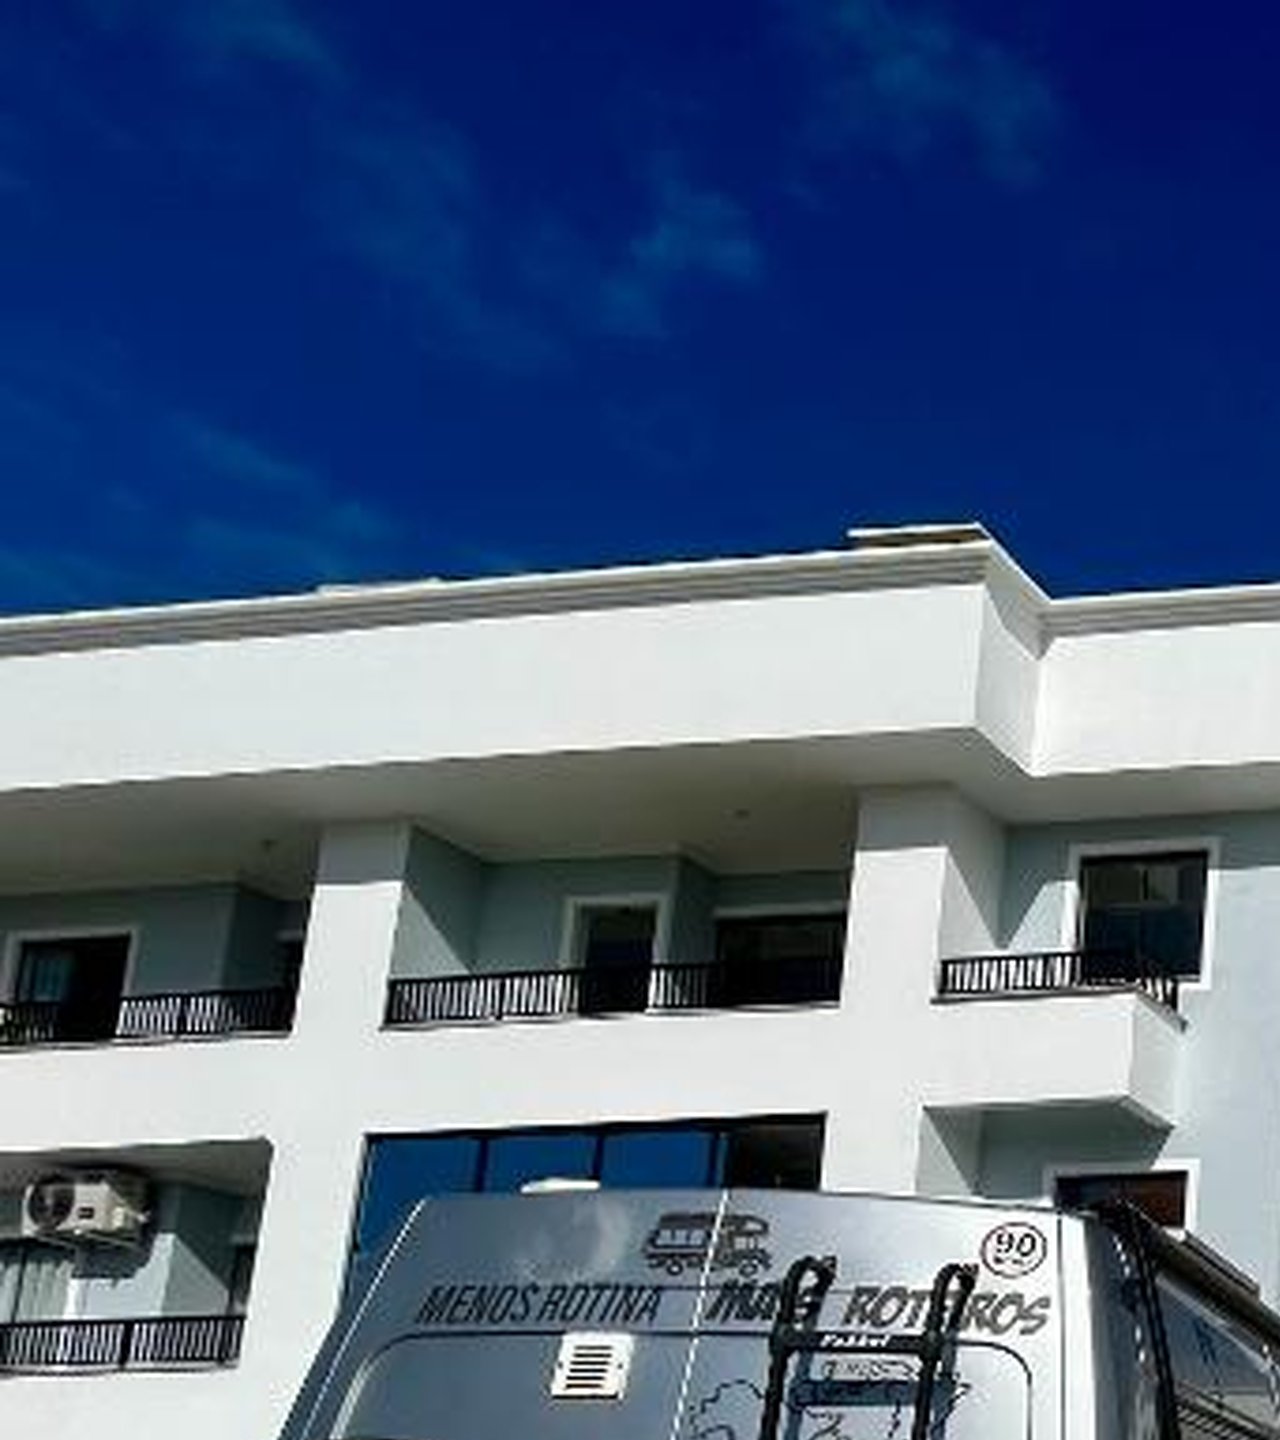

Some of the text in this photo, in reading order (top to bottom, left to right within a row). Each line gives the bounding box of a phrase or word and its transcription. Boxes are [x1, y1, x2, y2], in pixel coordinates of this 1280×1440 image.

[996, 1232, 1037, 1257] 90
[415, 1284, 538, 1325] MENOS
[537, 1283, 661, 1324] ROTINA
[844, 1286, 1050, 1335] ROTROS
